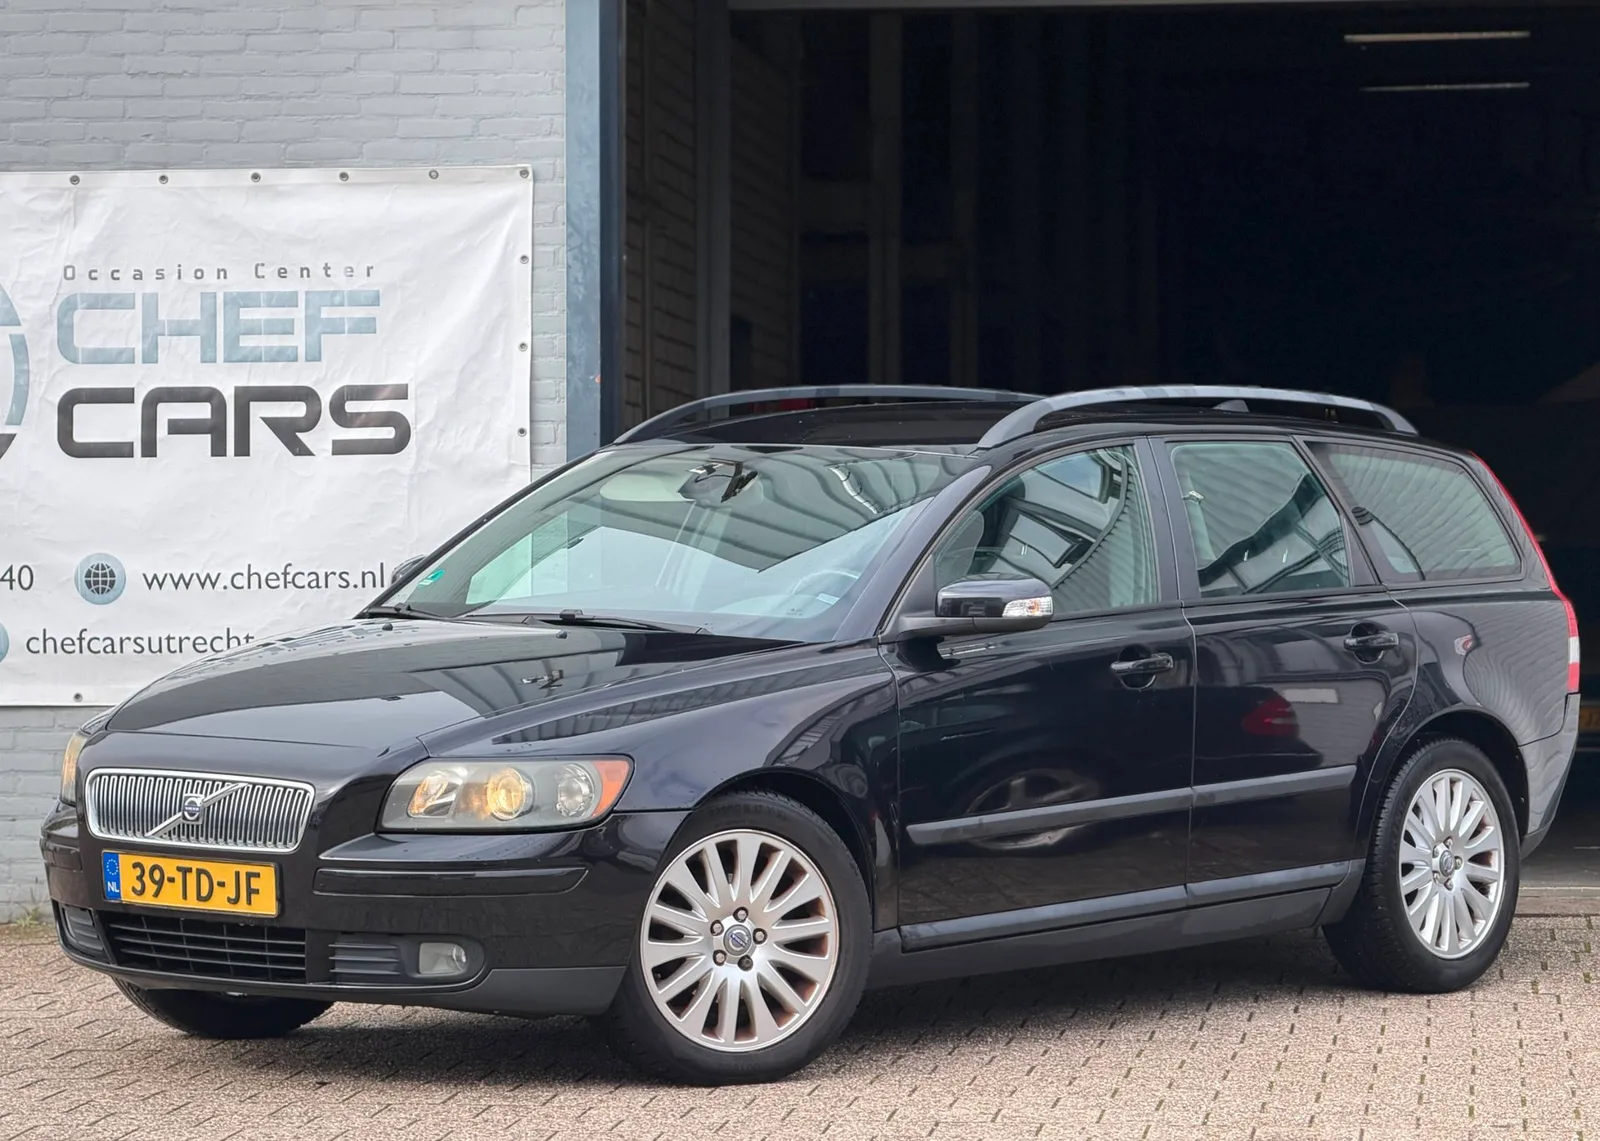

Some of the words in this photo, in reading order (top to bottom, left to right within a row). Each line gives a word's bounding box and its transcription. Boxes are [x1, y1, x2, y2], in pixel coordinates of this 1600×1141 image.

[63, 263, 228, 281] Occasion
[254, 261, 374, 279] Center
[57, 289, 381, 365] CHEF
[57, 383, 412, 459] CARS
[0, 564, 34, 591] 40
[142, 561, 385, 591] www.chefcars.nl
[107, 881, 120, 893] NL
[131, 861, 261, 906] 39-TD-JF
